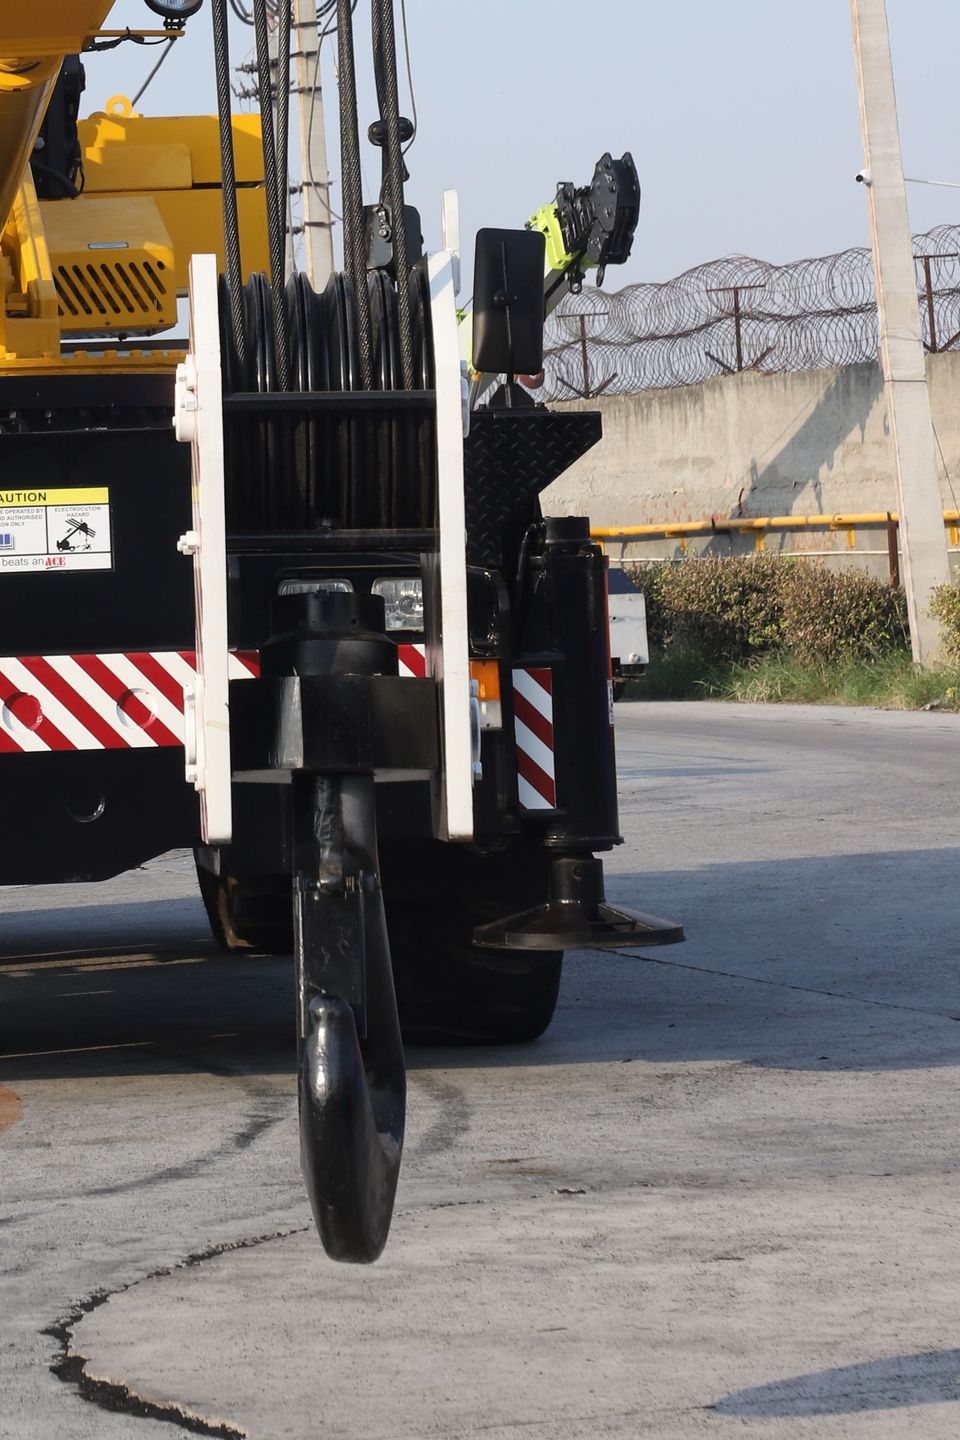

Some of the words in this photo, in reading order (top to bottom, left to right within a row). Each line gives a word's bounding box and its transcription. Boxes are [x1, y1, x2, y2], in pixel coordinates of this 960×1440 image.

[1, 558, 29, 567] beats
[31, 558, 44, 566] an
[45, 557, 66, 567] ACE
